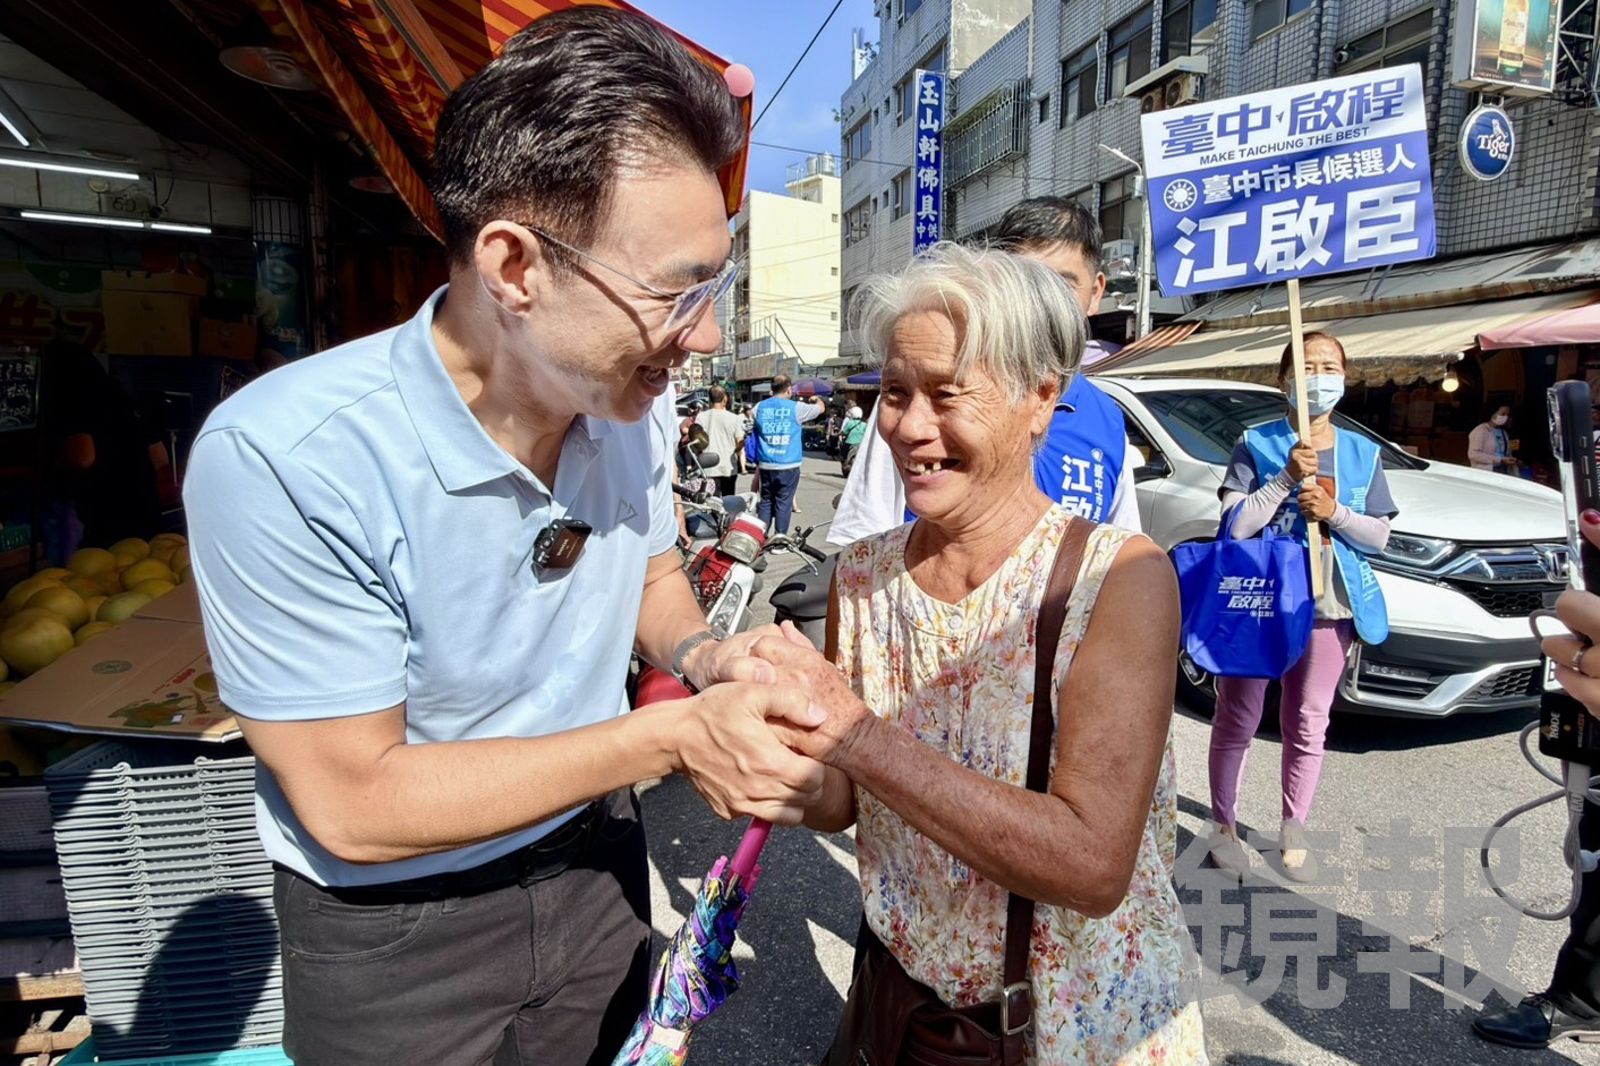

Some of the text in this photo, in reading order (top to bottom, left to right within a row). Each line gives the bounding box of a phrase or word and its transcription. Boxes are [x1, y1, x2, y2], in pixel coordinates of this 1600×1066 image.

[1200, 126, 1370, 166] MAKE TAICHUNG THE BEST
[1477, 134, 1510, 158] Tiger
[1202, 143, 1417, 205] 臺中市長候選人
[1173, 180, 1421, 288] 江啟臣
